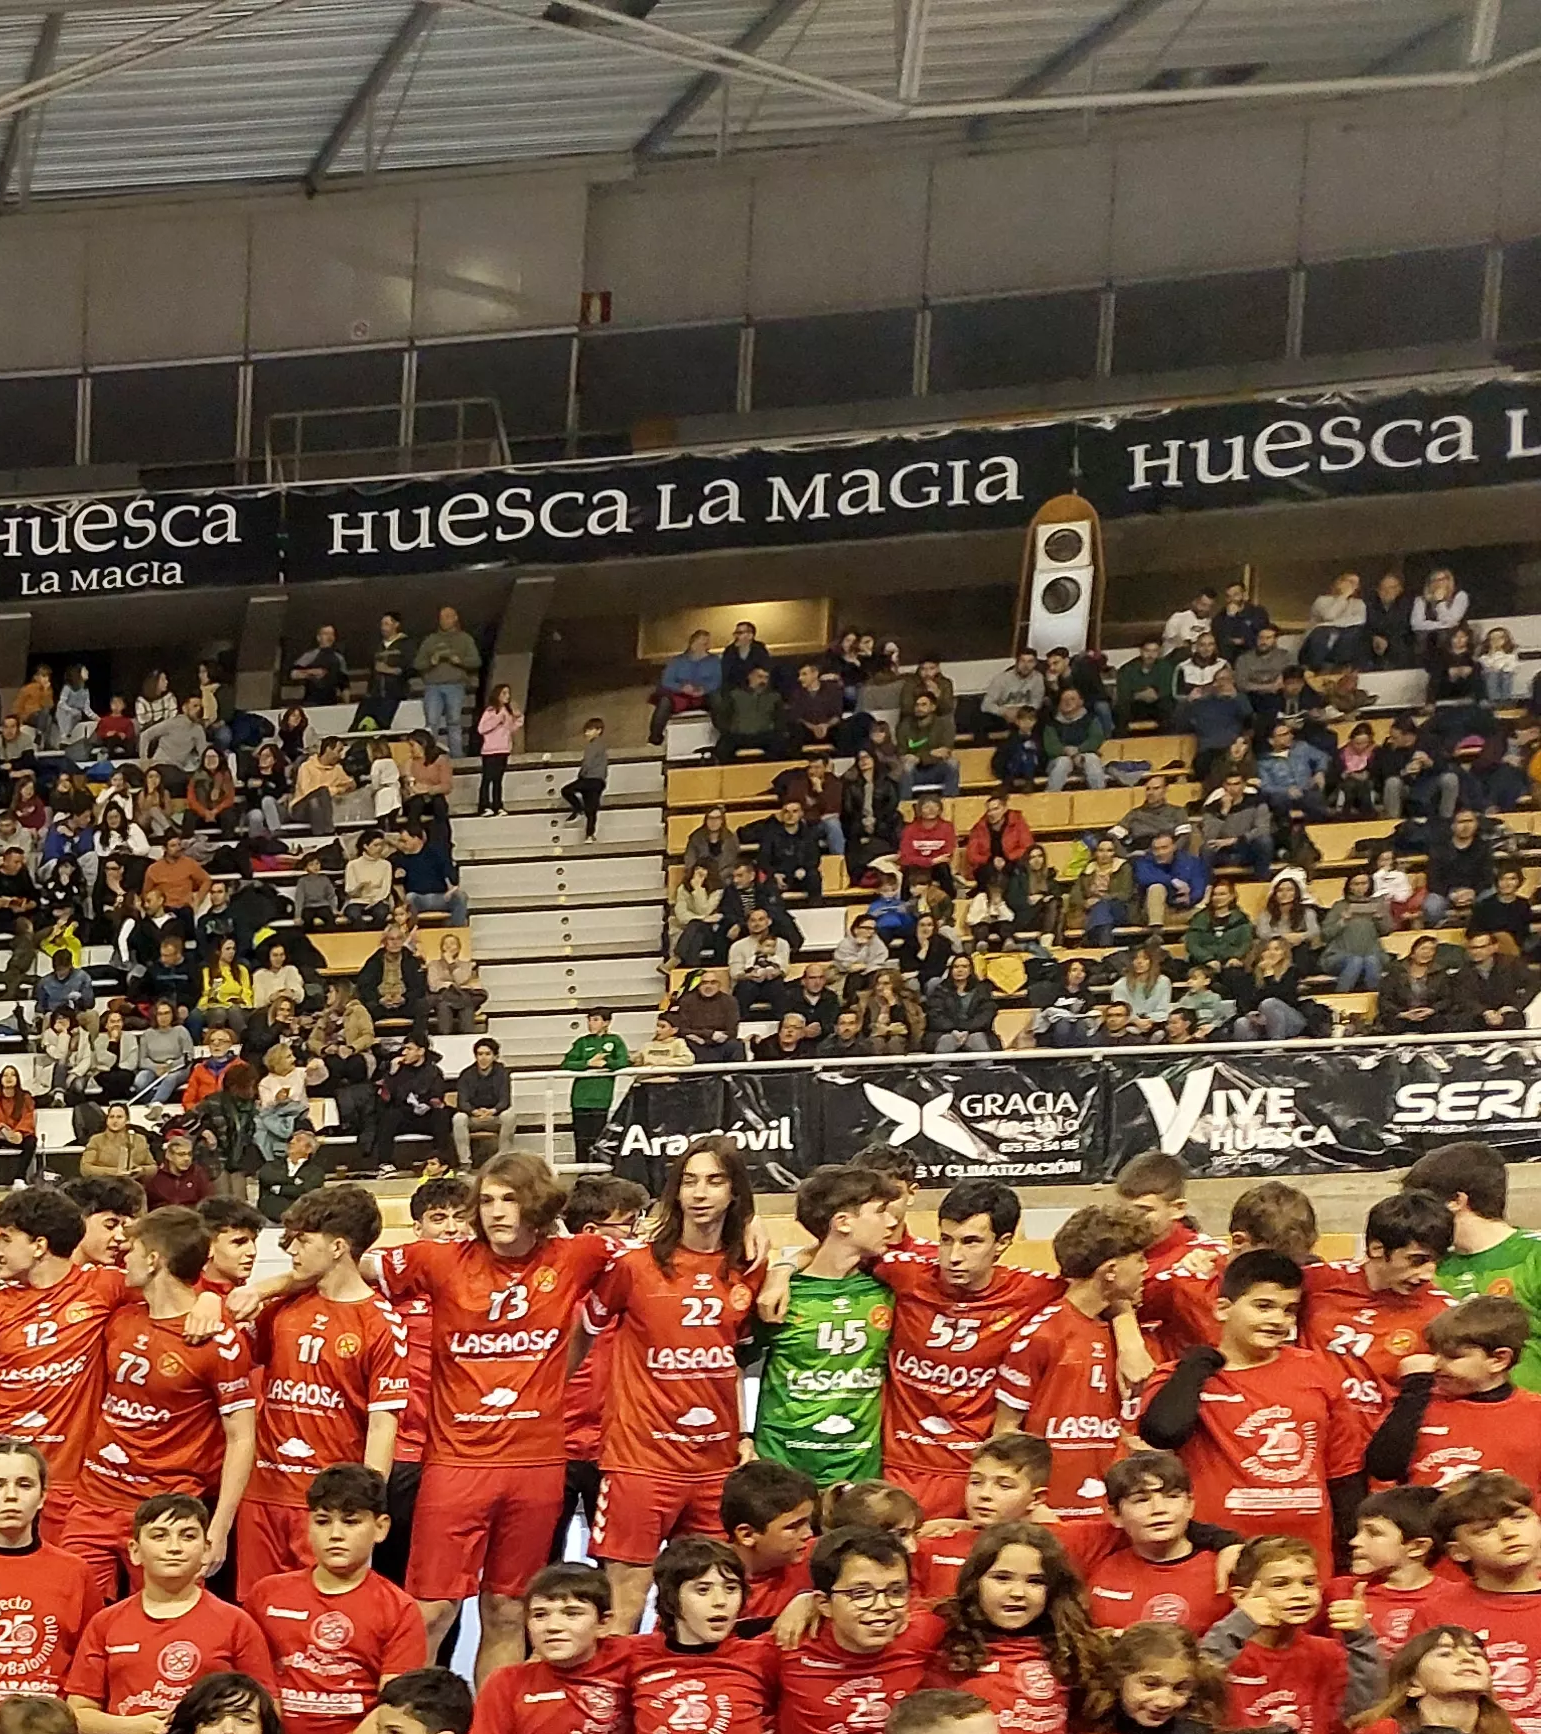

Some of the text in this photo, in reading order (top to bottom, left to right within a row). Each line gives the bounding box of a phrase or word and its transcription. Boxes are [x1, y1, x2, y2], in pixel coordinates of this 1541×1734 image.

[959, 1091, 1079, 1117] GRACIA
[620, 1116, 794, 1156] Araóvil
[1209, 1124, 1339, 1153] HUESCA
[680, 1298, 723, 1327] 22
[22, 1321, 59, 1347] 12
[818, 1319, 868, 1356] 45
[926, 1314, 982, 1352] 55
[297, 1334, 325, 1364] 11
[646, 1346, 736, 1372] LASAOS
[115, 1351, 151, 1386] 72
[1090, 1364, 1108, 1393] 4
